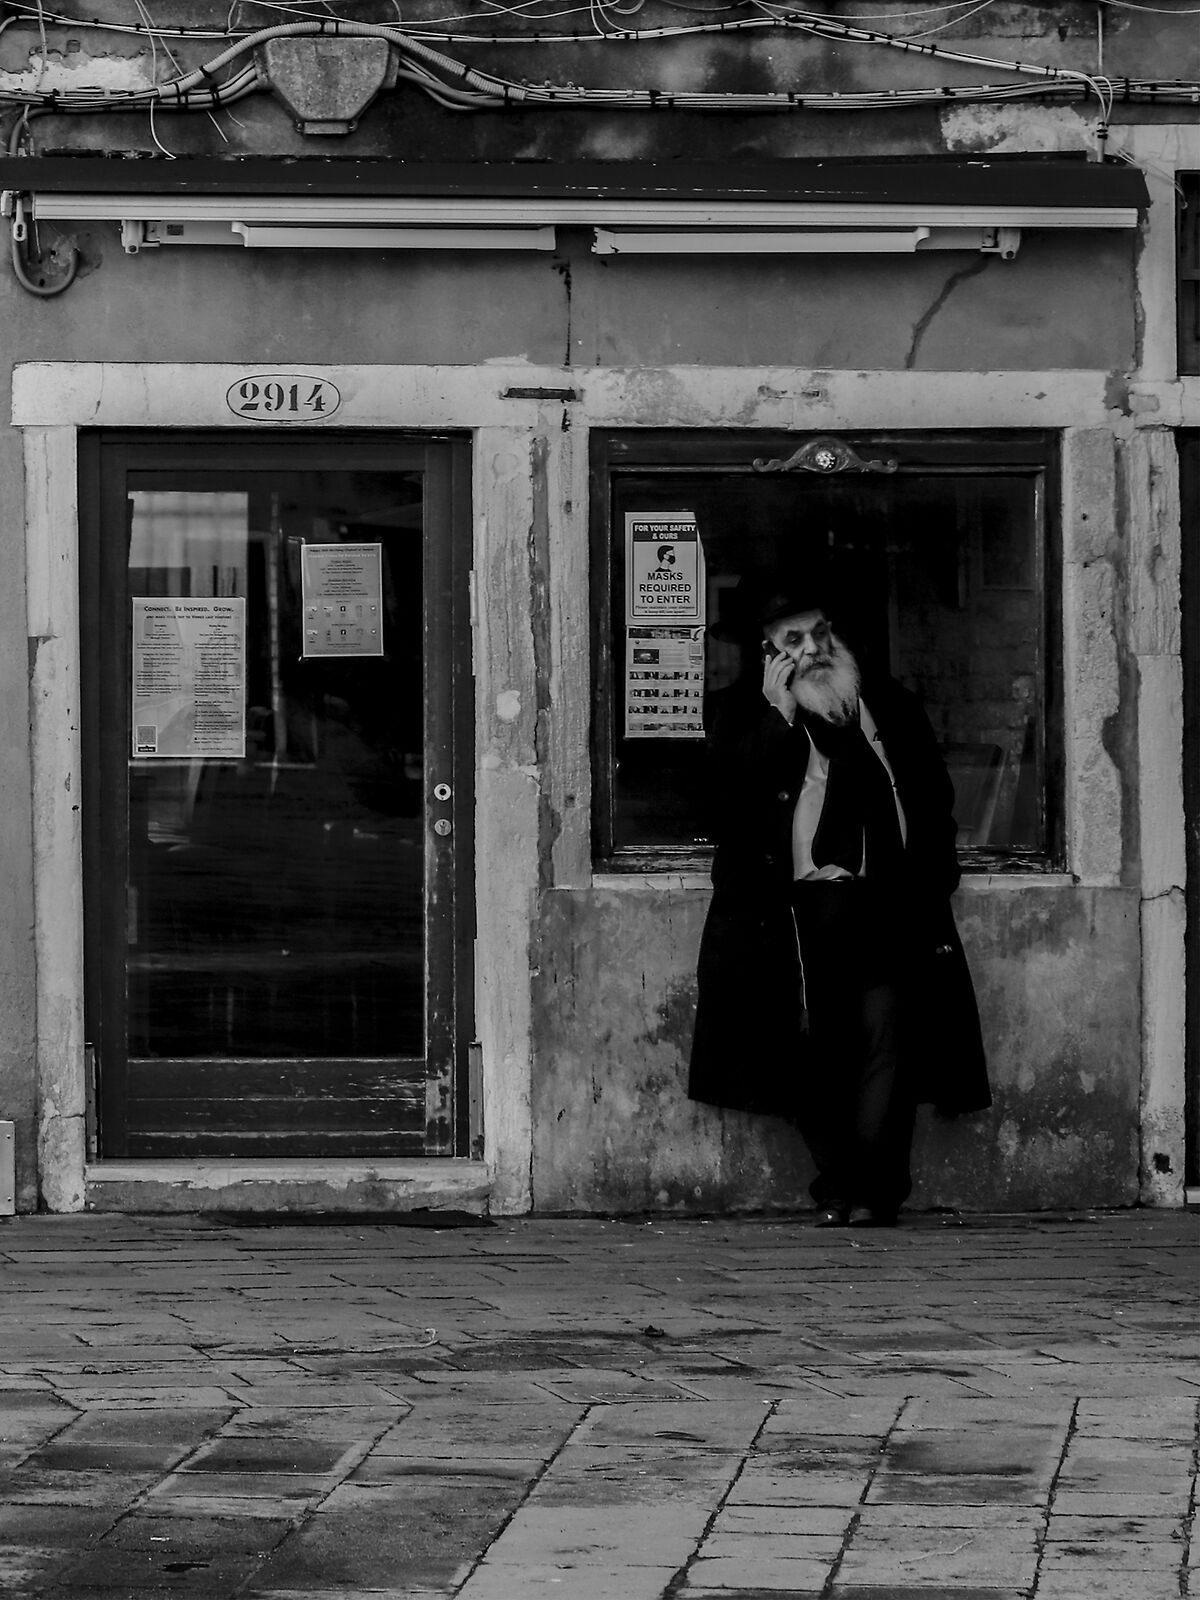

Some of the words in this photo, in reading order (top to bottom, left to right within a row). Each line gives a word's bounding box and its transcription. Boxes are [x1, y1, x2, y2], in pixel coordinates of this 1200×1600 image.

[240, 382, 326, 412] 2914
[634, 524, 649, 532] FOR
[649, 524, 669, 532] YOUR
[669, 524, 696, 532] SAFETY
[647, 572, 683, 581] MASKS
[639, 584, 692, 592] REQUIRED
[640, 595, 654, 604] TO
[657, 595, 691, 604] ENTER
